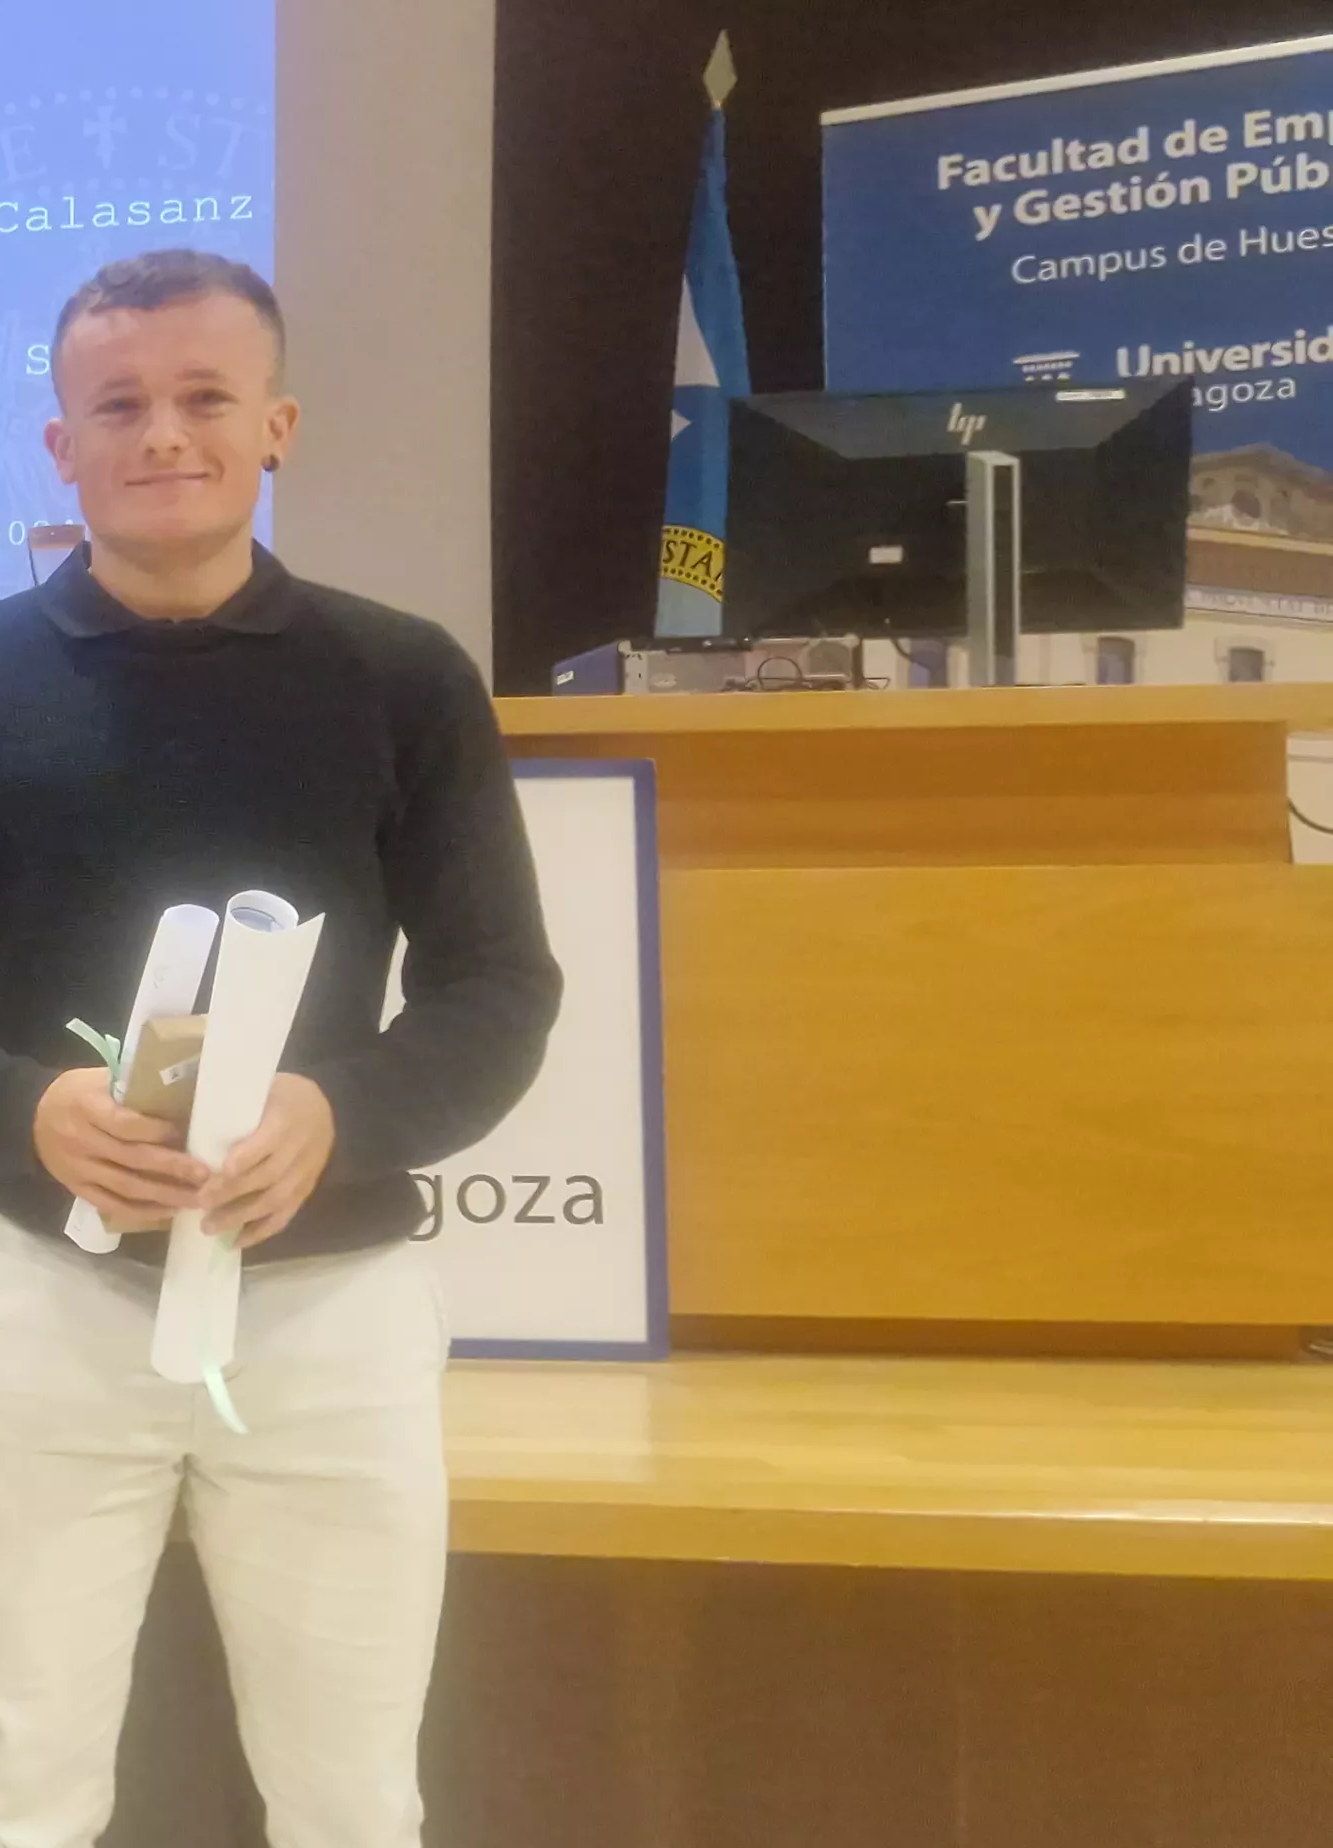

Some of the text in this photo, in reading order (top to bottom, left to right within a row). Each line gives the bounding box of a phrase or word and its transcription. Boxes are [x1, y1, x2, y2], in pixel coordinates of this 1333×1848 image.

[937, 110, 1333, 190] Facultad de Em
[973, 152, 1330, 242] y Gestión Púb
[1012, 243, 1167, 285] Campus
[1178, 233, 1228, 266] de
[1117, 324, 1333, 378] Universid
[947, 402, 987, 445] hp
[662, 539, 721, 582] STA
[406, 1173, 604, 1242] goza
